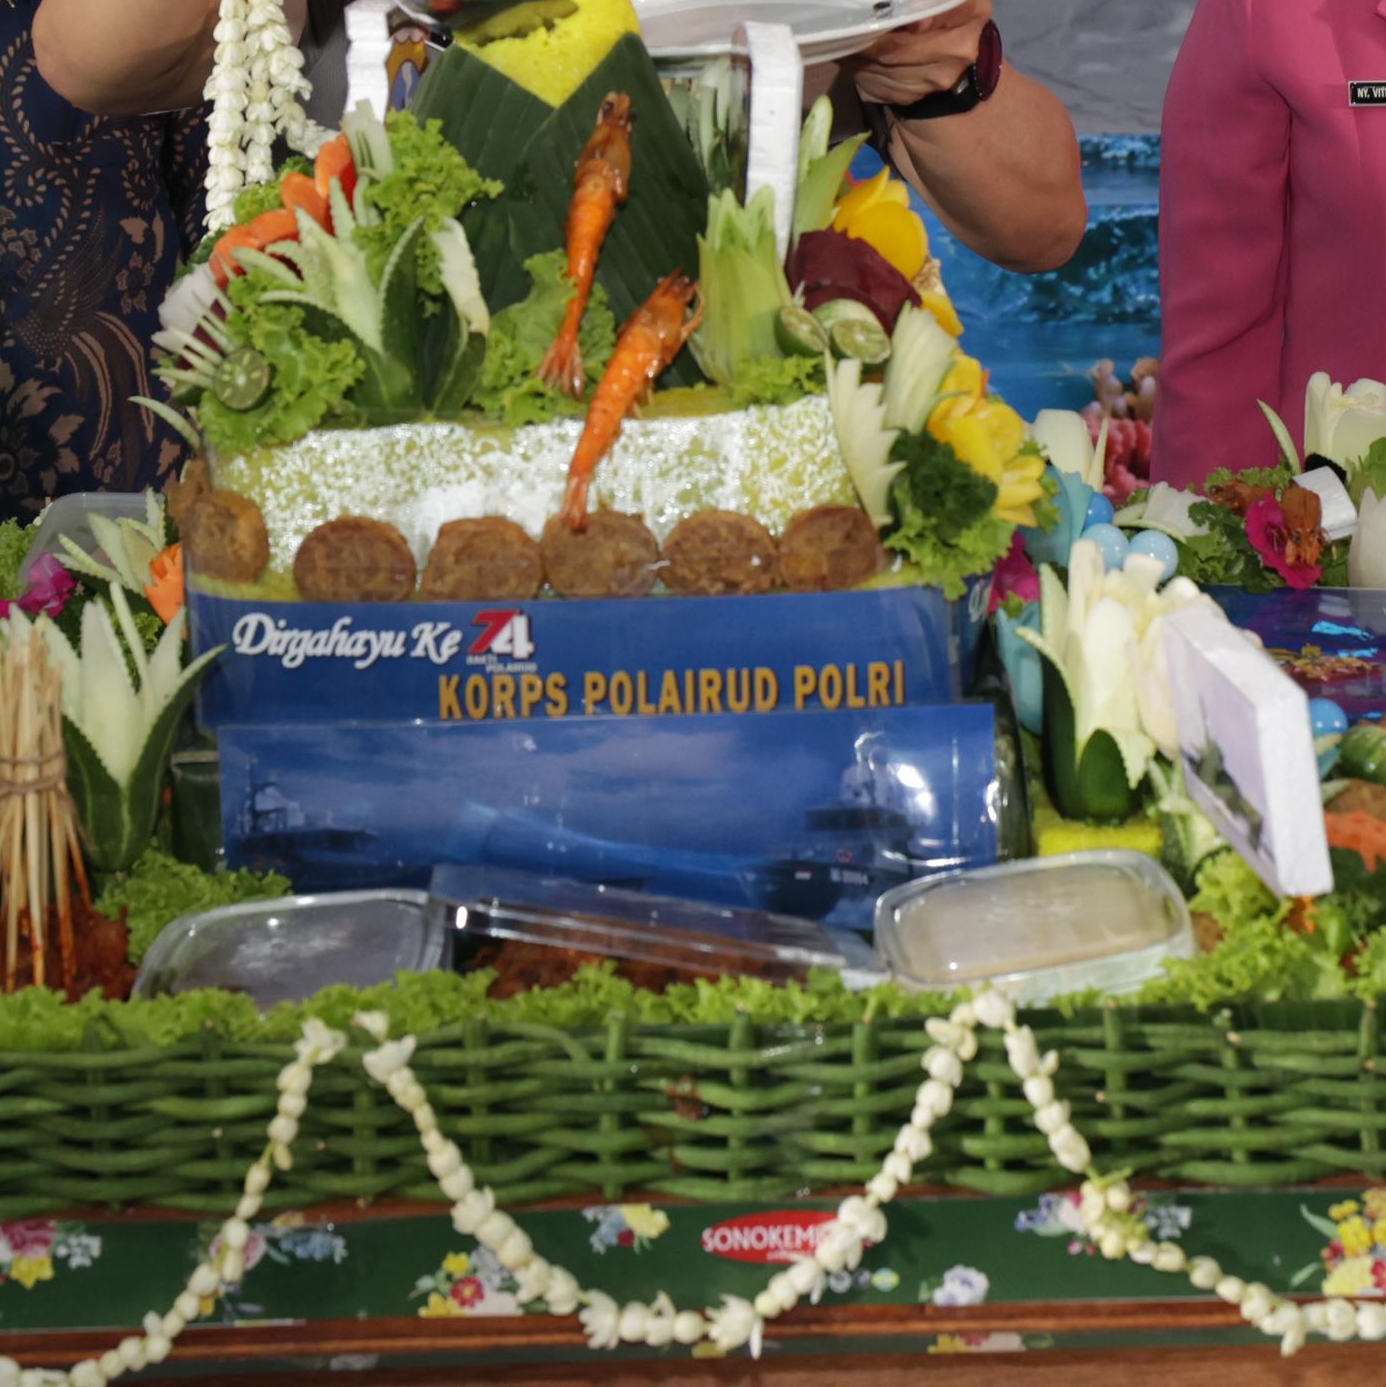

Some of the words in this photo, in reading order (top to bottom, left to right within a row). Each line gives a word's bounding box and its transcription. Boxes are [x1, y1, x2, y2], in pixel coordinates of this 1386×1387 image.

[231, 612, 407, 669] Dirgahayu
[410, 621, 463, 664] Ke
[467, 608, 535, 659] 74
[438, 673, 568, 721] KORPS
[583, 667, 778, 716] POLAIRUD
[794, 660, 905, 710] POLRI
